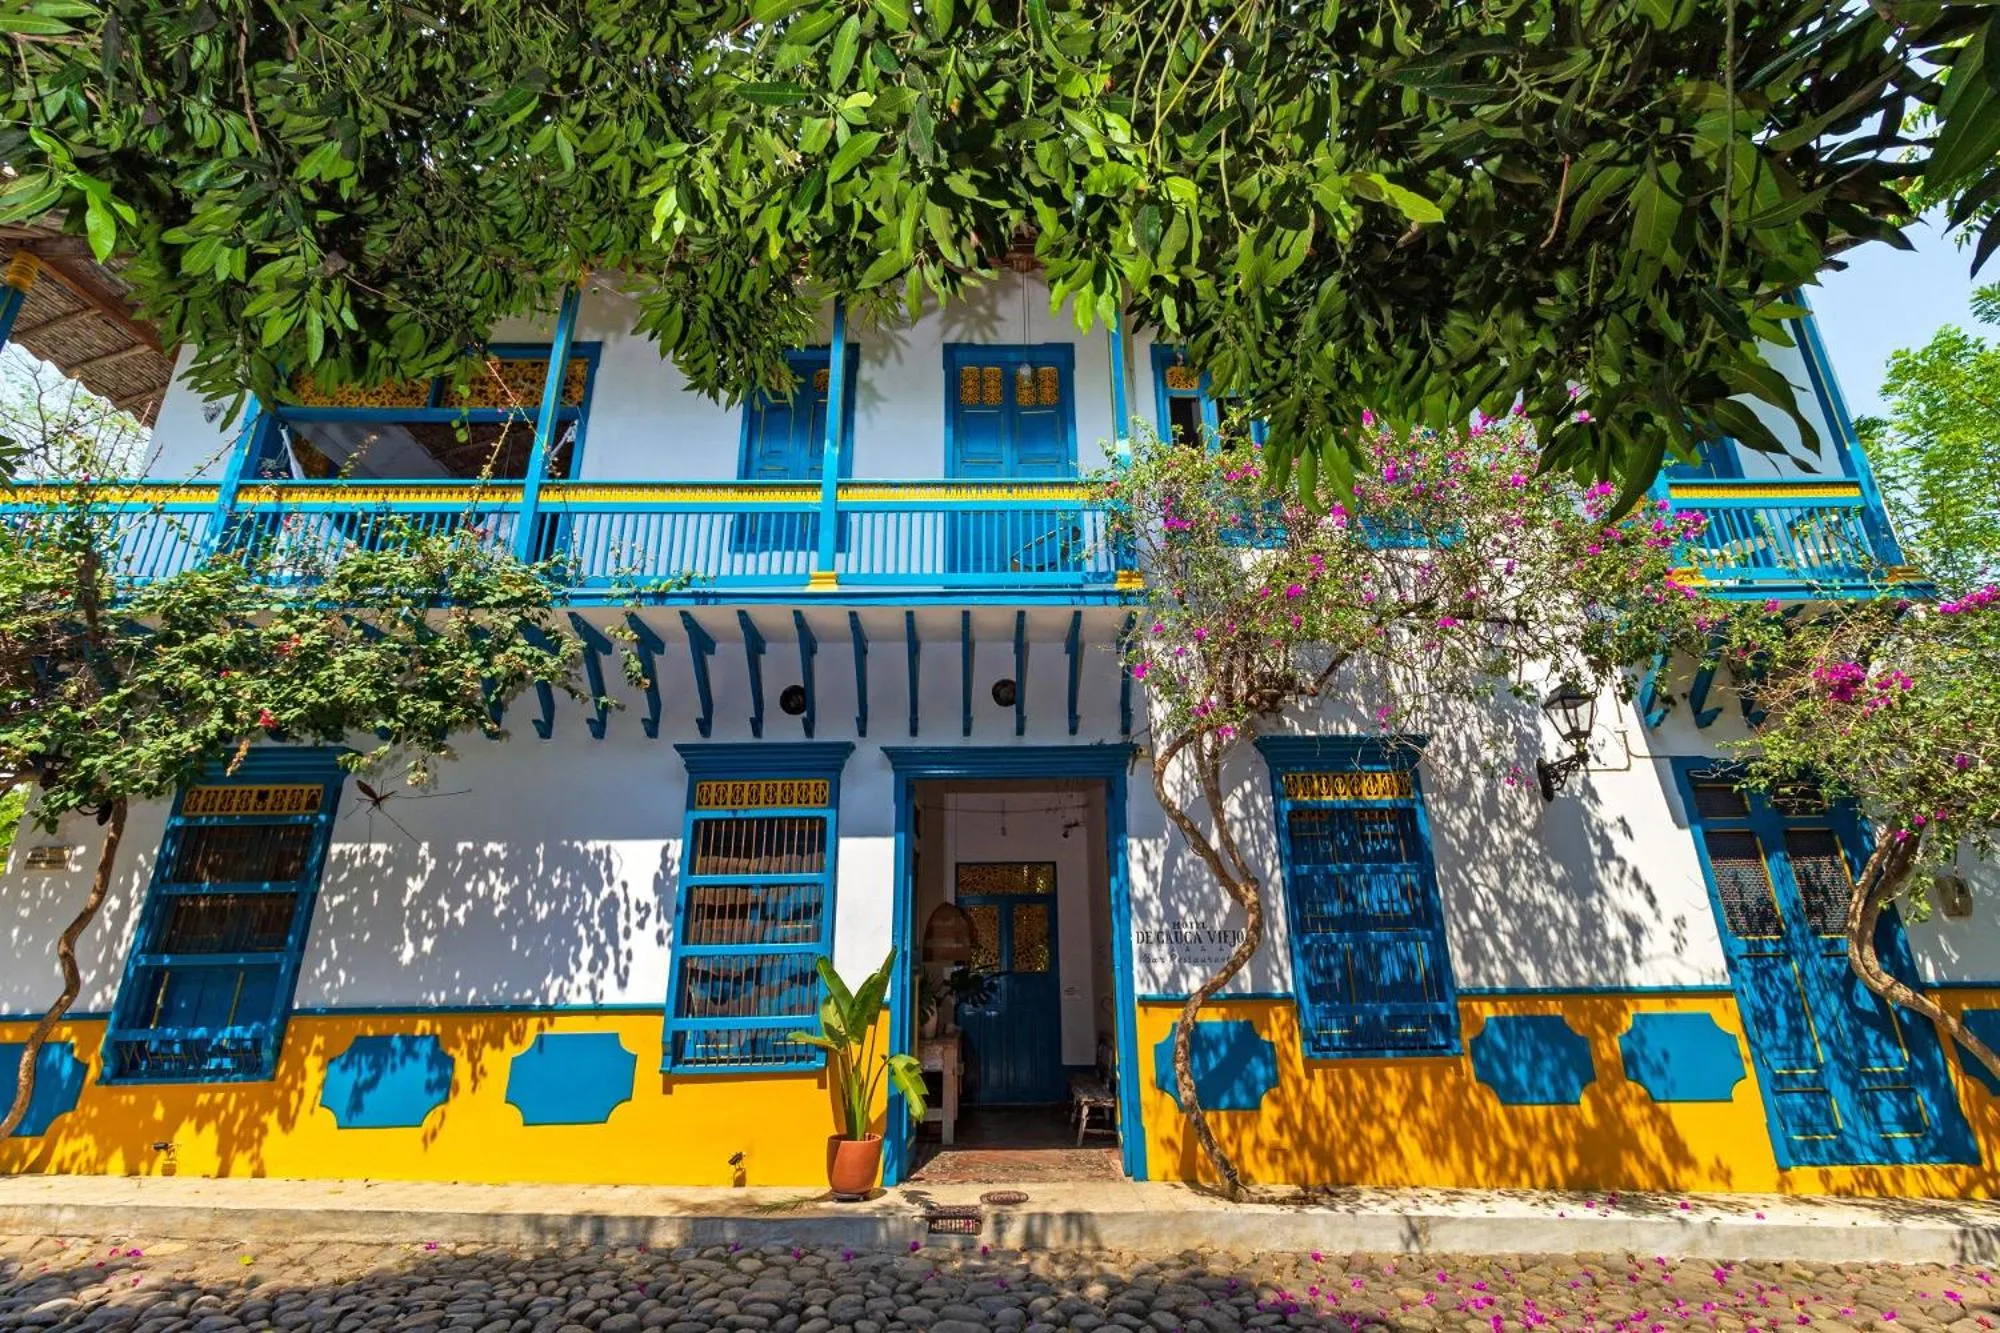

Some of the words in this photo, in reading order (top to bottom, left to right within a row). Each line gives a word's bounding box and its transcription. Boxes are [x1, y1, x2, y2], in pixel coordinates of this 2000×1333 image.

[1172, 921, 1207, 930] HOTEL
[1136, 931, 1153, 944] DE
[1156, 931, 1203, 945] CAUCA
[1207, 930, 1246, 947] VIEJO
